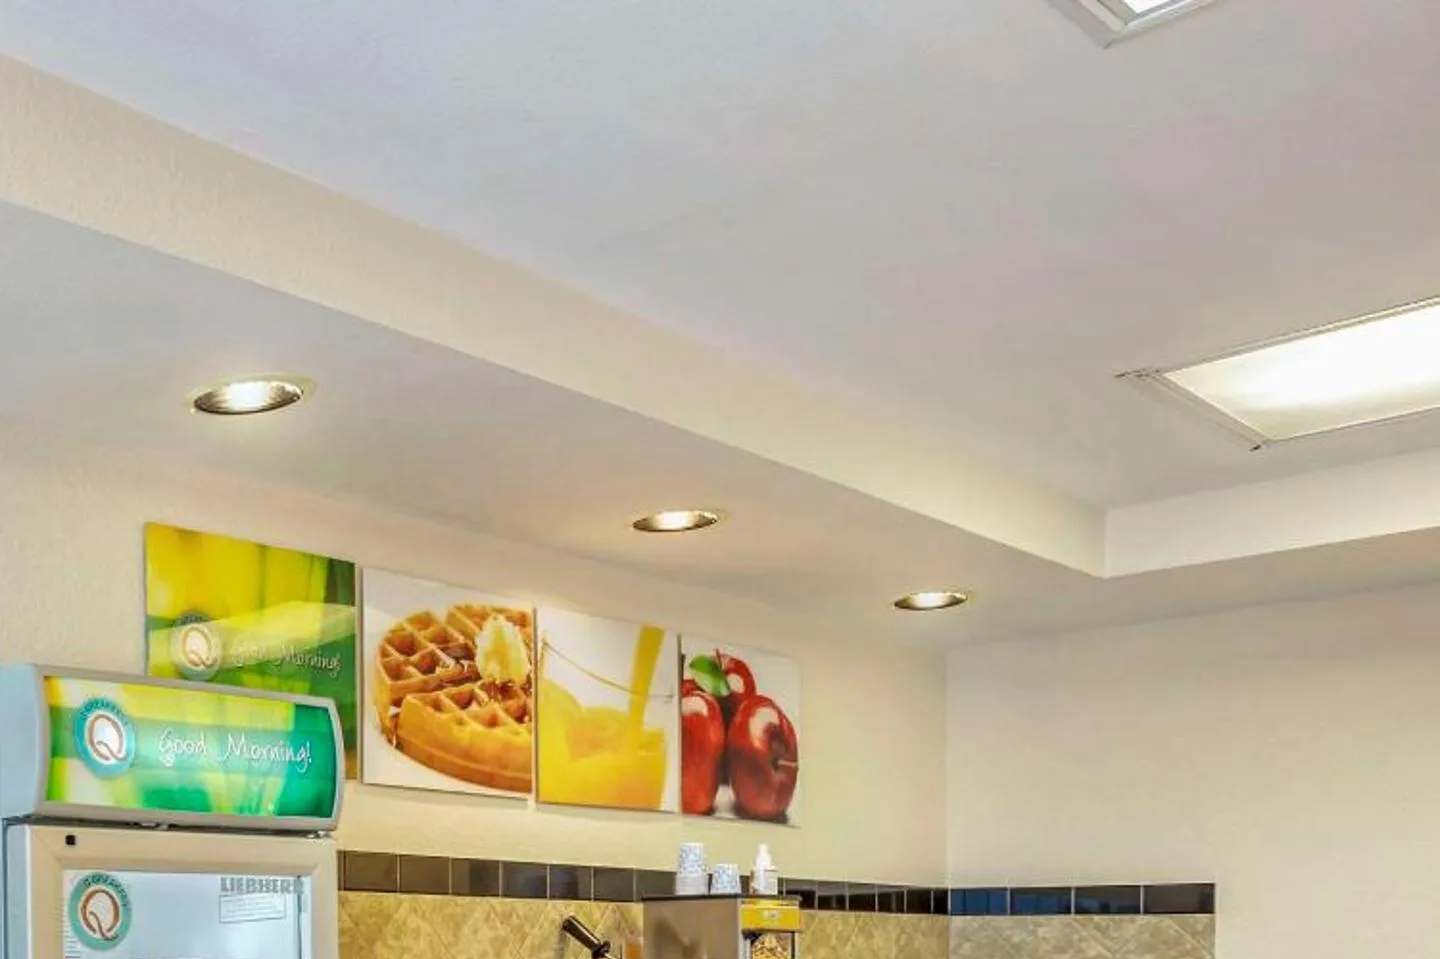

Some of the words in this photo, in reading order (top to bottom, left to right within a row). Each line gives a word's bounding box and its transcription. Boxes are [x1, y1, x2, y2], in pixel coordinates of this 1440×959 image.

[159, 728, 207, 767] Good
[215, 733, 312, 773] Morning!
[220, 876, 304, 894] LIEBHERR
